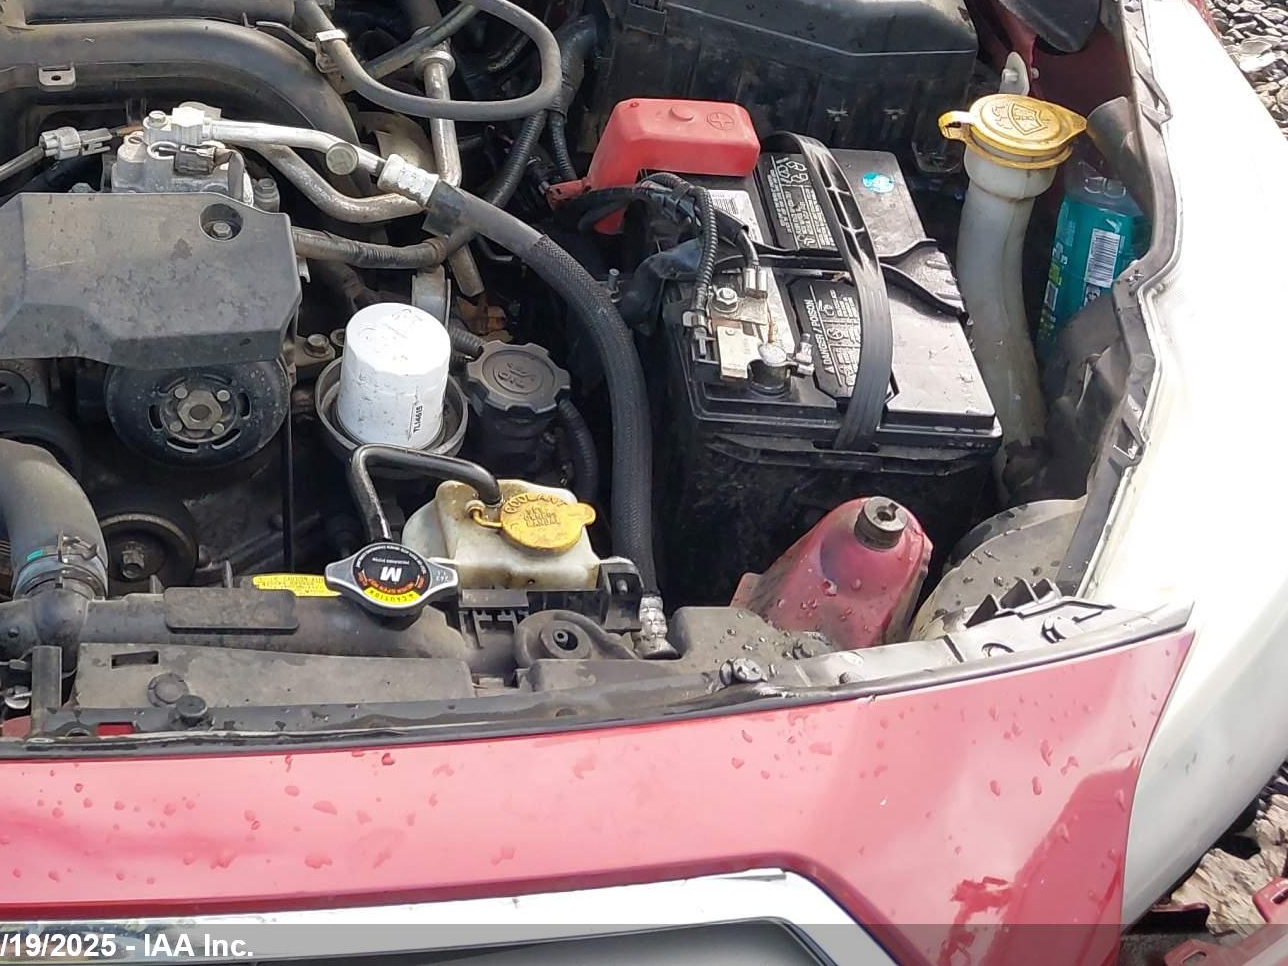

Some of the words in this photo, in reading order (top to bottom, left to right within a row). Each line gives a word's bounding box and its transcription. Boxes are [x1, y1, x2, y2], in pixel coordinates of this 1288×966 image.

[804, 299, 820, 328] POISON
[815, 332, 833, 365] DANGER
[379, 566, 403, 582] M
